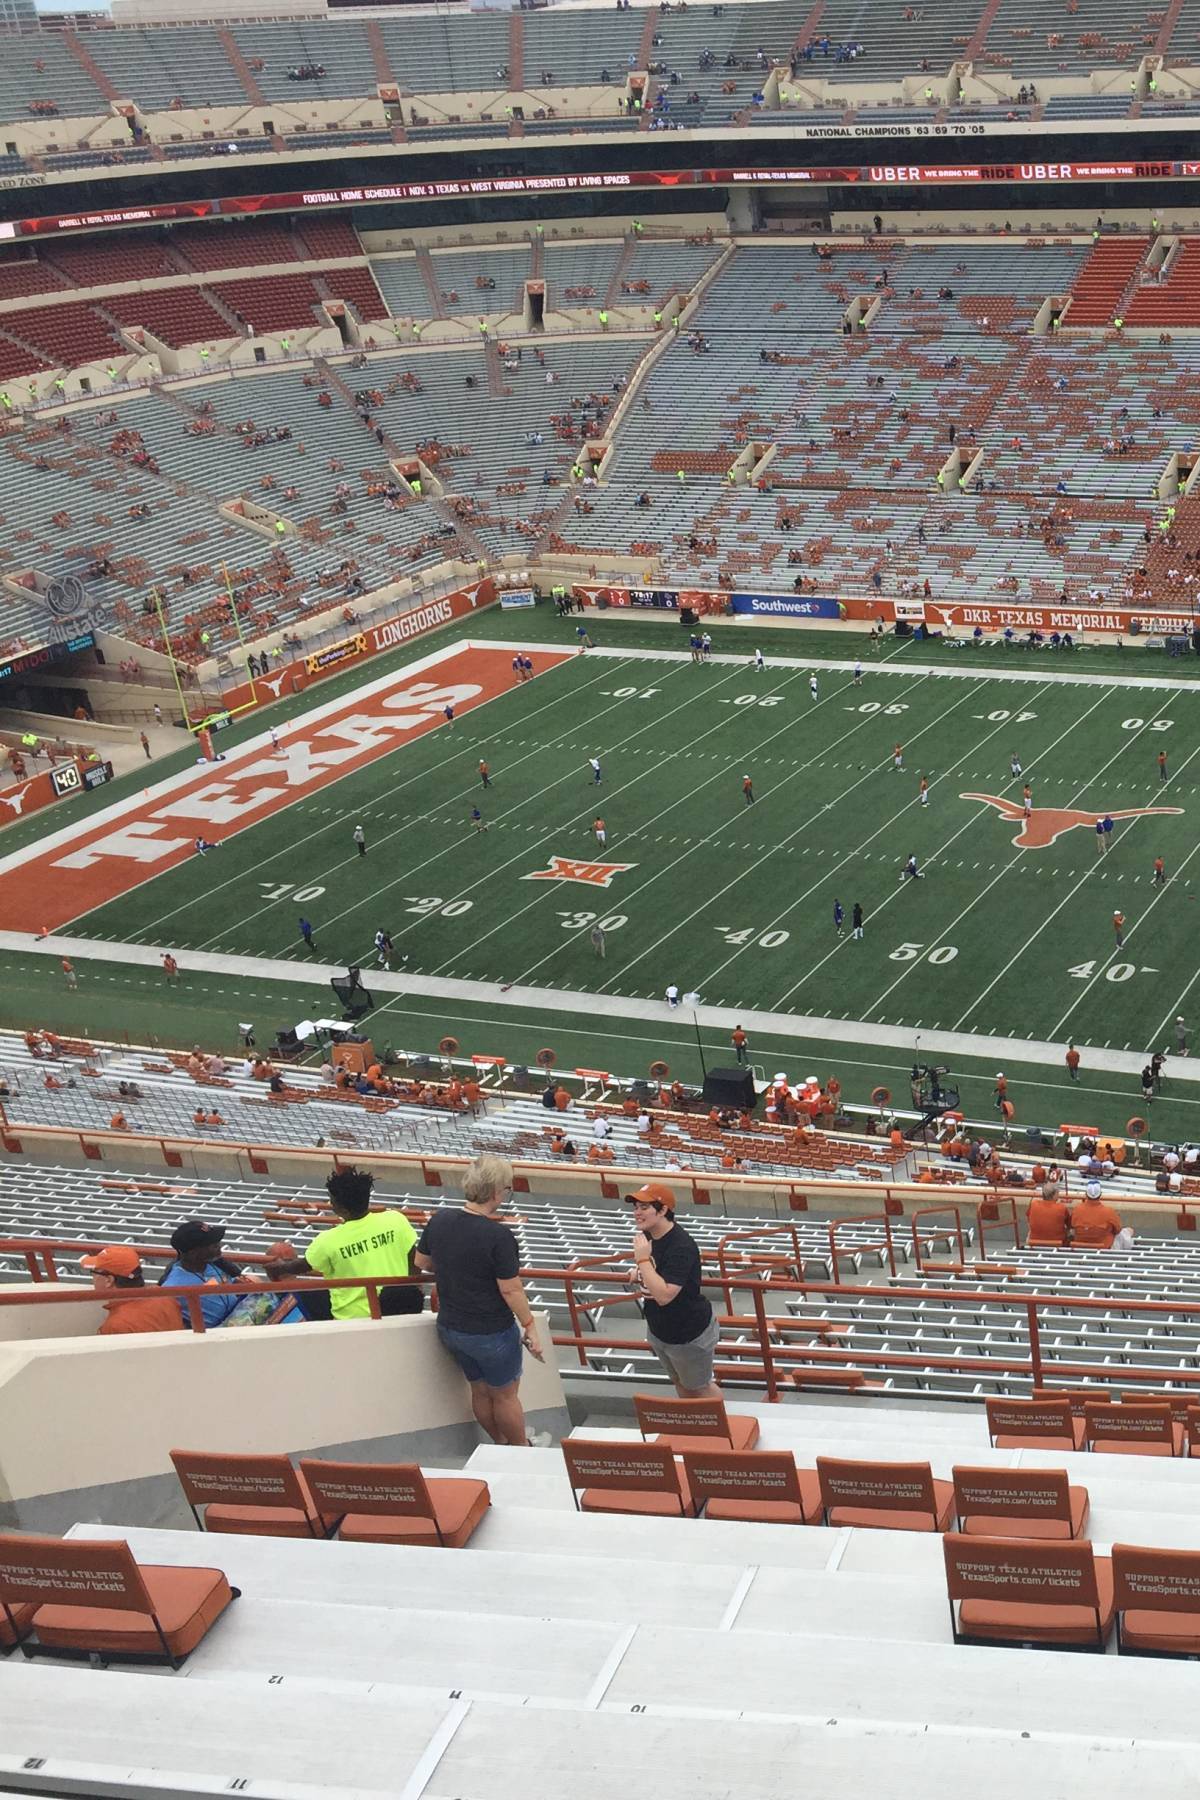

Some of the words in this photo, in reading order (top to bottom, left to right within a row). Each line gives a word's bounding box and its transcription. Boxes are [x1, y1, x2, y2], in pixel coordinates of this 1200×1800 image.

[805, 126, 853, 138] NATIONAL
[854, 125, 912, 137] CHAMPIONS
[913, 125, 930, 136] '63
[932, 125, 949, 136] '69
[950, 125, 967, 135] '70
[968, 124, 986, 135] '05
[871, 166, 922, 182] UBER
[924, 169, 938, 178] WE
[938, 169, 962, 178] BRING
[962, 169, 980, 178] THE
[981, 166, 1015, 179] RIDE
[1020, 164, 1073, 180] UBER
[1076, 167, 1090, 176] WE
[1090, 167, 1117, 176] BRING
[1117, 166, 1134, 175] THE
[1135, 165, 1171, 177] RIDE
[18, 175, 47, 187] ZONE
[302, 192, 340, 204] FOOTBALL
[341, 190, 363, 201] HOME
[364, 187, 402, 200] SCHEDULE
[409, 186, 428, 196] NOV.
[428, 185, 435, 195] 3
[435, 183, 460, 194] TEXAS
[470, 181, 493, 192] WEST
[493, 179, 525, 191] VIRGINIA
[525, 178, 567, 189] PRESENTED
[567, 177, 578, 186] BY
[578, 176, 602, 186] LIVING
[603, 175, 631, 185] SPACES
[751, 599, 812, 614] Southwest
[49, 606, 107, 644] Allstate
[373, 600, 454, 650] LONGHORNS
[963, 608, 1044, 626] DKR-TEXAS
[1049, 610, 1125, 630] MEMORIAL
[608, 687, 663, 700] 10
[732, 693, 787, 708] 20
[856, 701, 911, 716] 30
[985, 708, 1040, 724] 40
[1121, 717, 1176, 733] 50
[49, 682, 484, 870] TEXAS
[56, 770, 78, 789] 40
[262, 883, 327, 903] 10
[405, 896, 474, 918] 20
[561, 911, 629, 932] 30
[724, 925, 791, 949] 40
[888, 942, 959, 965] 50
[1066, 959, 1136, 983] 40
[339, 1239, 369, 1260] EVENT
[370, 1230, 395, 1249] STAFF
[572, 1458, 603, 1468] SUPPORT
[603, 1460, 627, 1468] TEXAS
[627, 1462, 665, 1470] ATHLETICS
[693, 1468, 724, 1477] SUPPORT
[724, 1470, 748, 1478] TEXAS
[749, 1471, 787, 1480] ATHLETICS
[828, 1479, 860, 1488] SUPPORT
[860, 1480, 884, 1489] TEXAS
[884, 1481, 923, 1491] ATHLETICS
[961, 1487, 993, 1496] SUPPORT
[993, 1489, 1018, 1497] TEXAS
[1018, 1490, 1058, 1498] ATHLETICS
[36, 1567, 70, 1579] TEXAS
[71, 1570, 125, 1581] ATHLETICS
[955, 1562, 996, 1574] SUPPORT
[998, 1563, 1030, 1575] TEXAS
[1031, 1566, 1082, 1578] ATHLETICS
[1, 1573, 127, 1593] TexasSports.com/tickets
[959, 1571, 1081, 1588] TexasSports.com/tickets
[1124, 1573, 1167, 1585] SUPPORT
[1168, 1575, 1200, 1586] TEXAS
[23, 1757, 45, 1769] 12
[229, 1778, 248, 1790] 11
